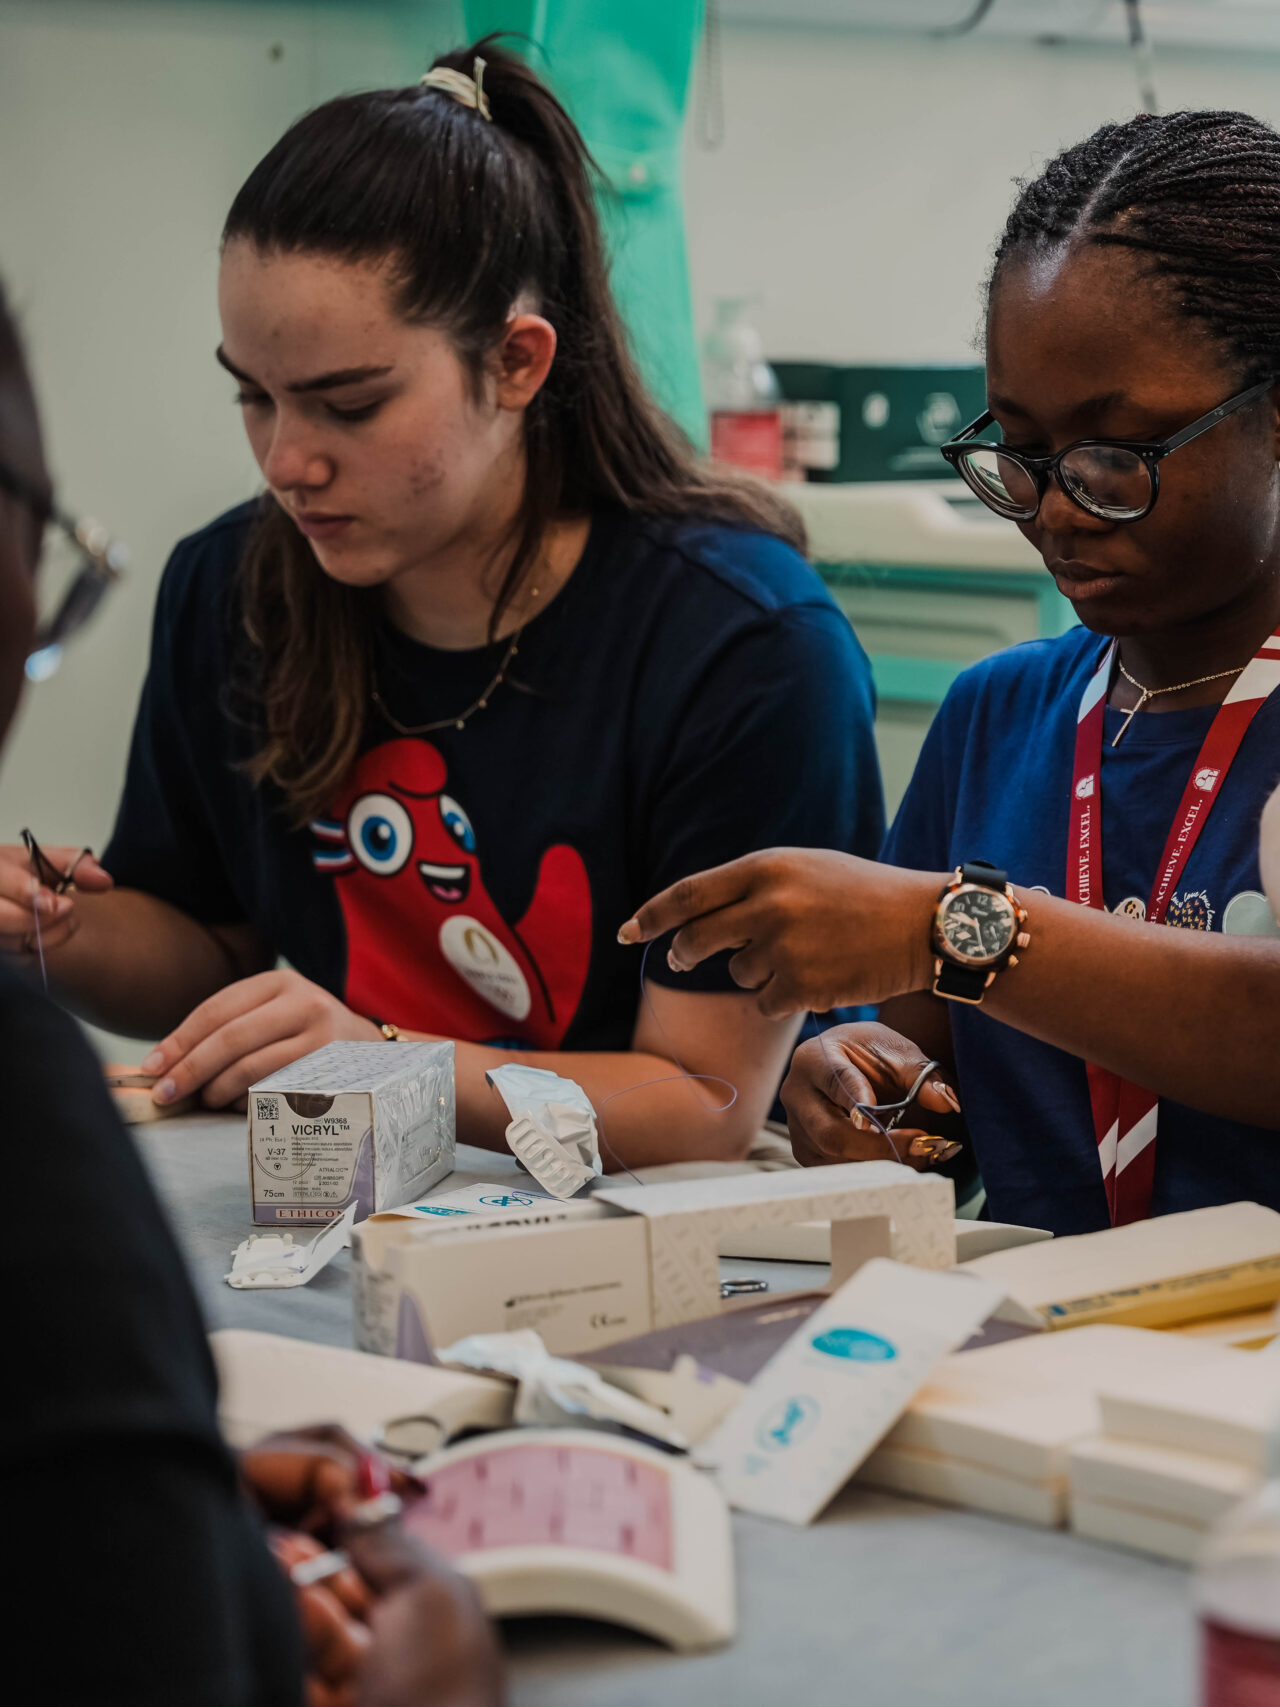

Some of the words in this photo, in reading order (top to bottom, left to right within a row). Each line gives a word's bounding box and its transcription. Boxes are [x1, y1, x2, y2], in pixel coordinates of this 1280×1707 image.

[1079, 804, 1091, 849] EXCEL.
[1156, 845, 1184, 904] ACHIEVE.
[1177, 799, 1203, 842] EXCEL.
[269, 1125, 275, 1136] 1
[267, 1148, 286, 1156] V-37
[263, 1189, 285, 1198] 75cm
